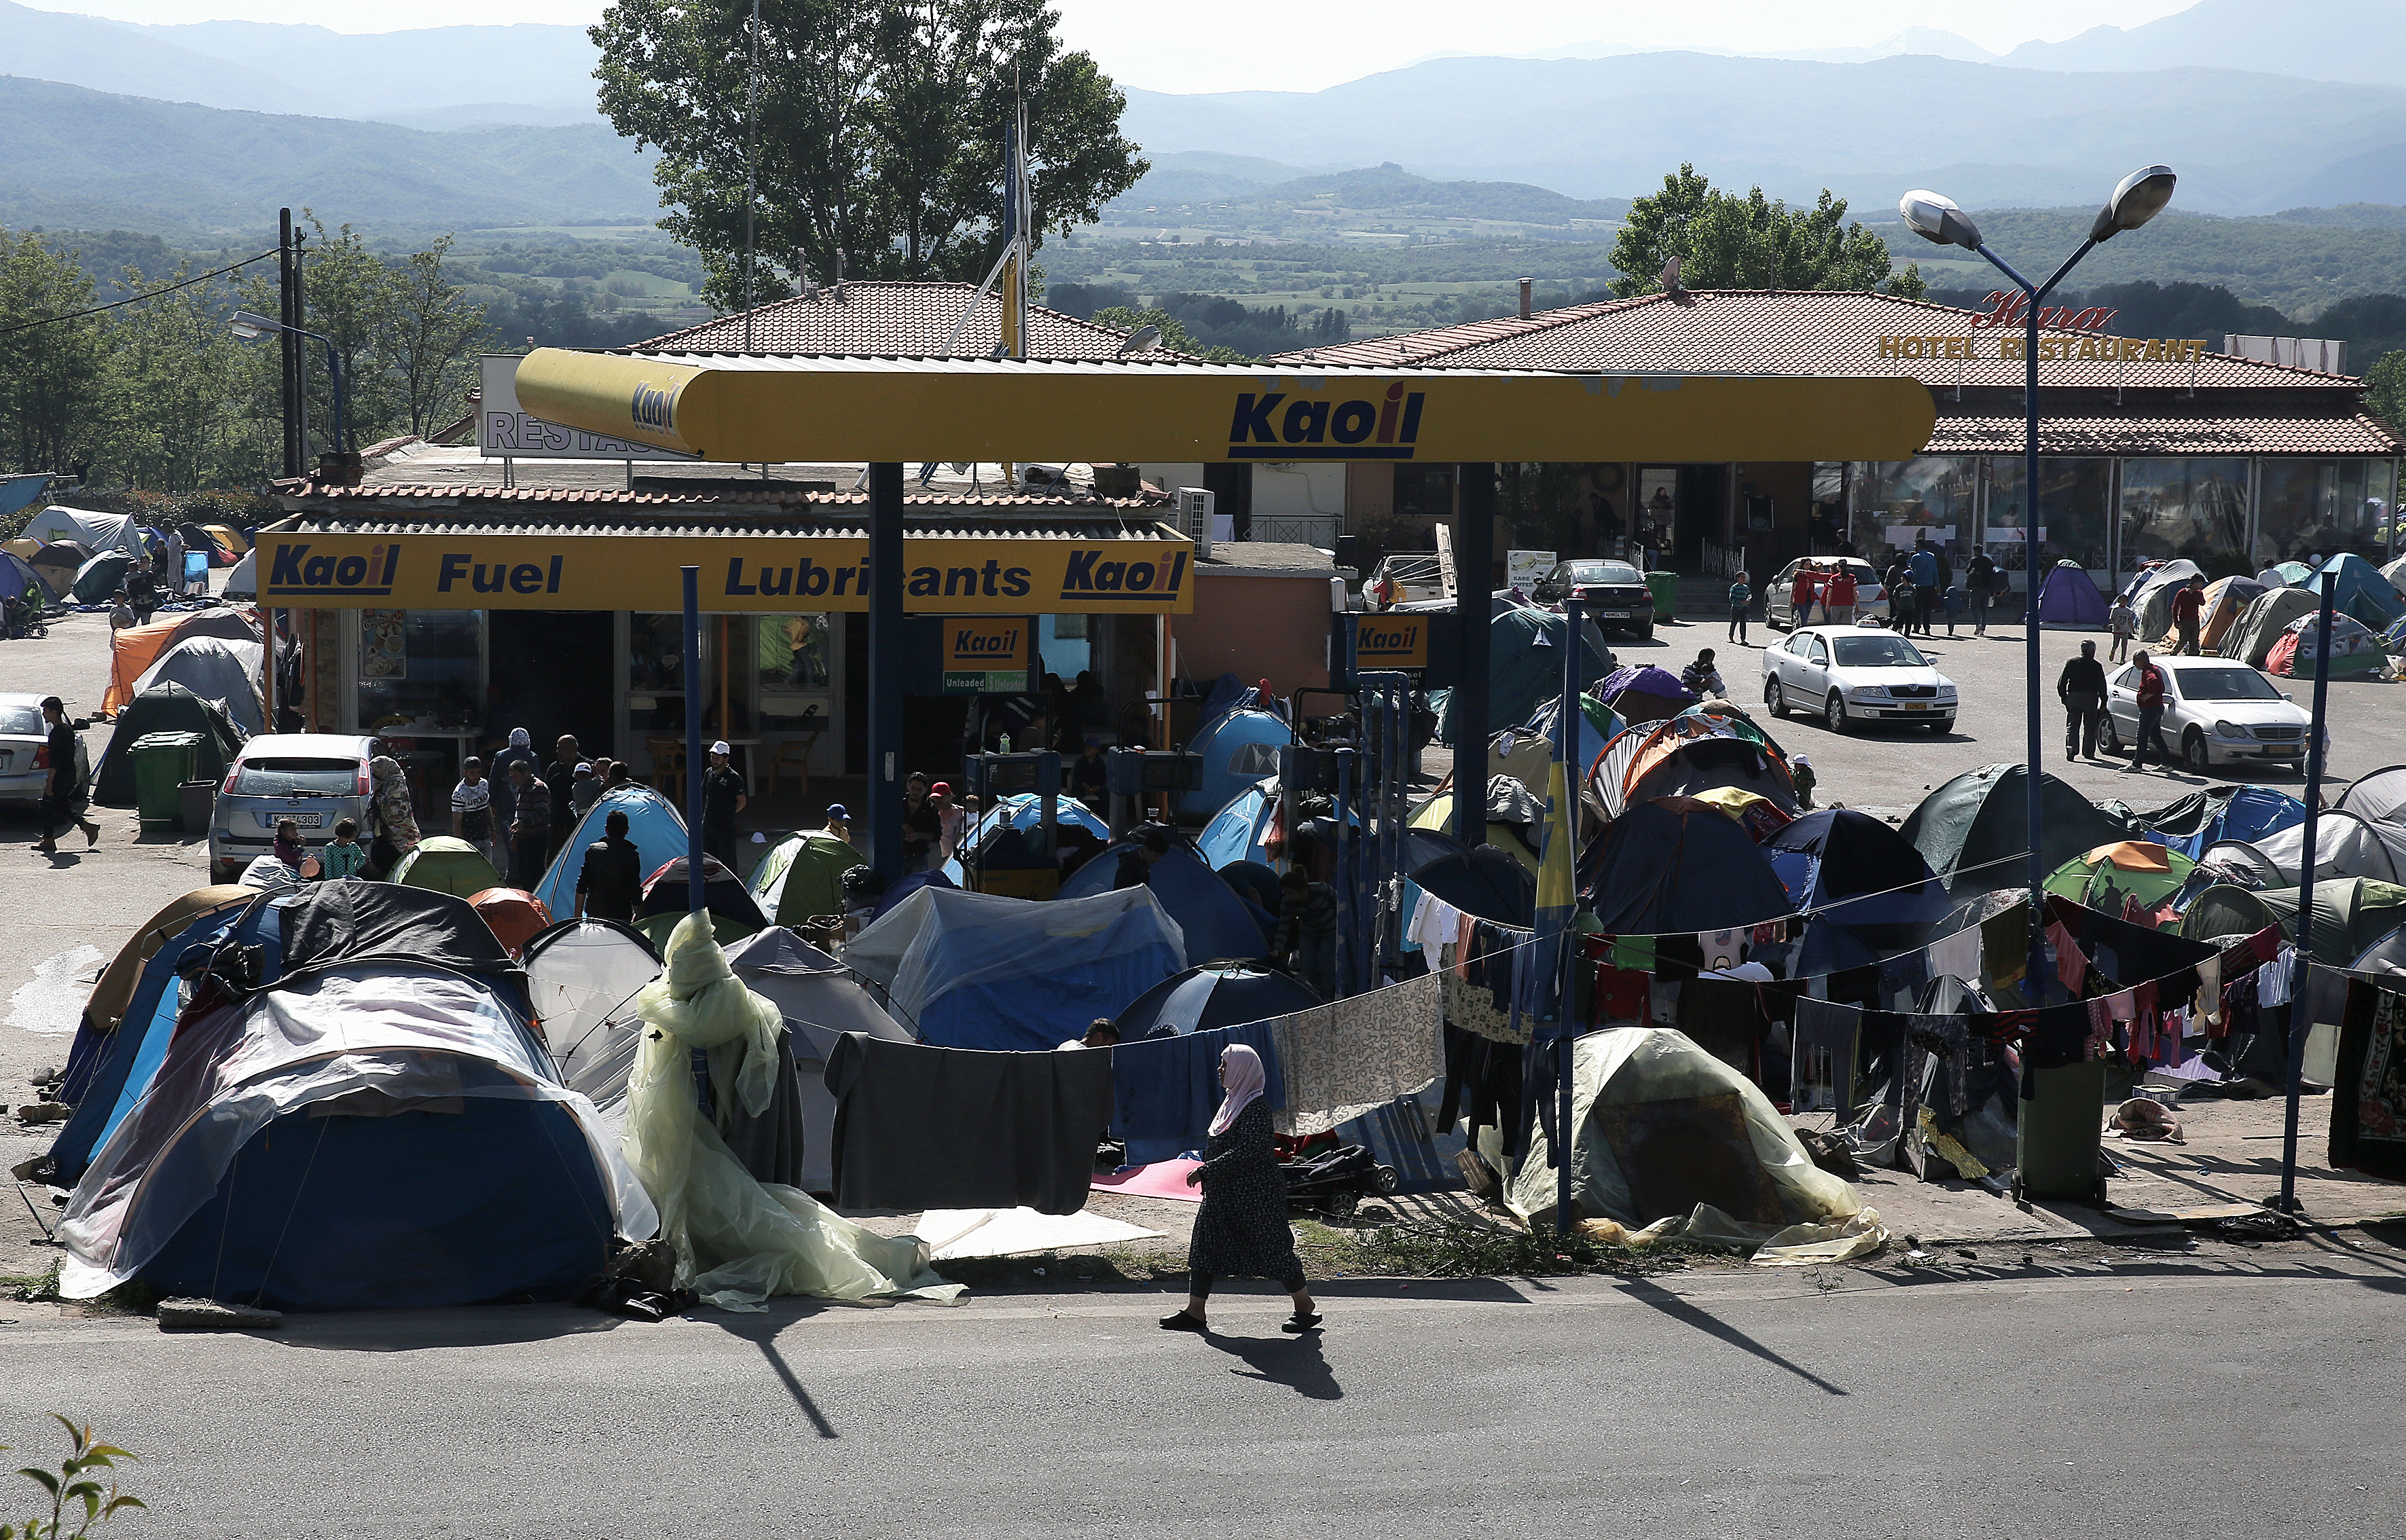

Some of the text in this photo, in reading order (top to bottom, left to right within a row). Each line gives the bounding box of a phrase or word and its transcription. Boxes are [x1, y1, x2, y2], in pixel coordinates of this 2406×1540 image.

[1880, 336, 1977, 359] HOTEL
[632, 377, 682, 435] Kaoil
[1228, 380, 1425, 443] Kaoil
[270, 543, 1188, 598] Kaoil Fuel Lubriants Kaoil
[954, 629, 1018, 652] Kaoil
[1357, 626, 1418, 648] Kaoil
[946, 678, 985, 687] Unleaded
